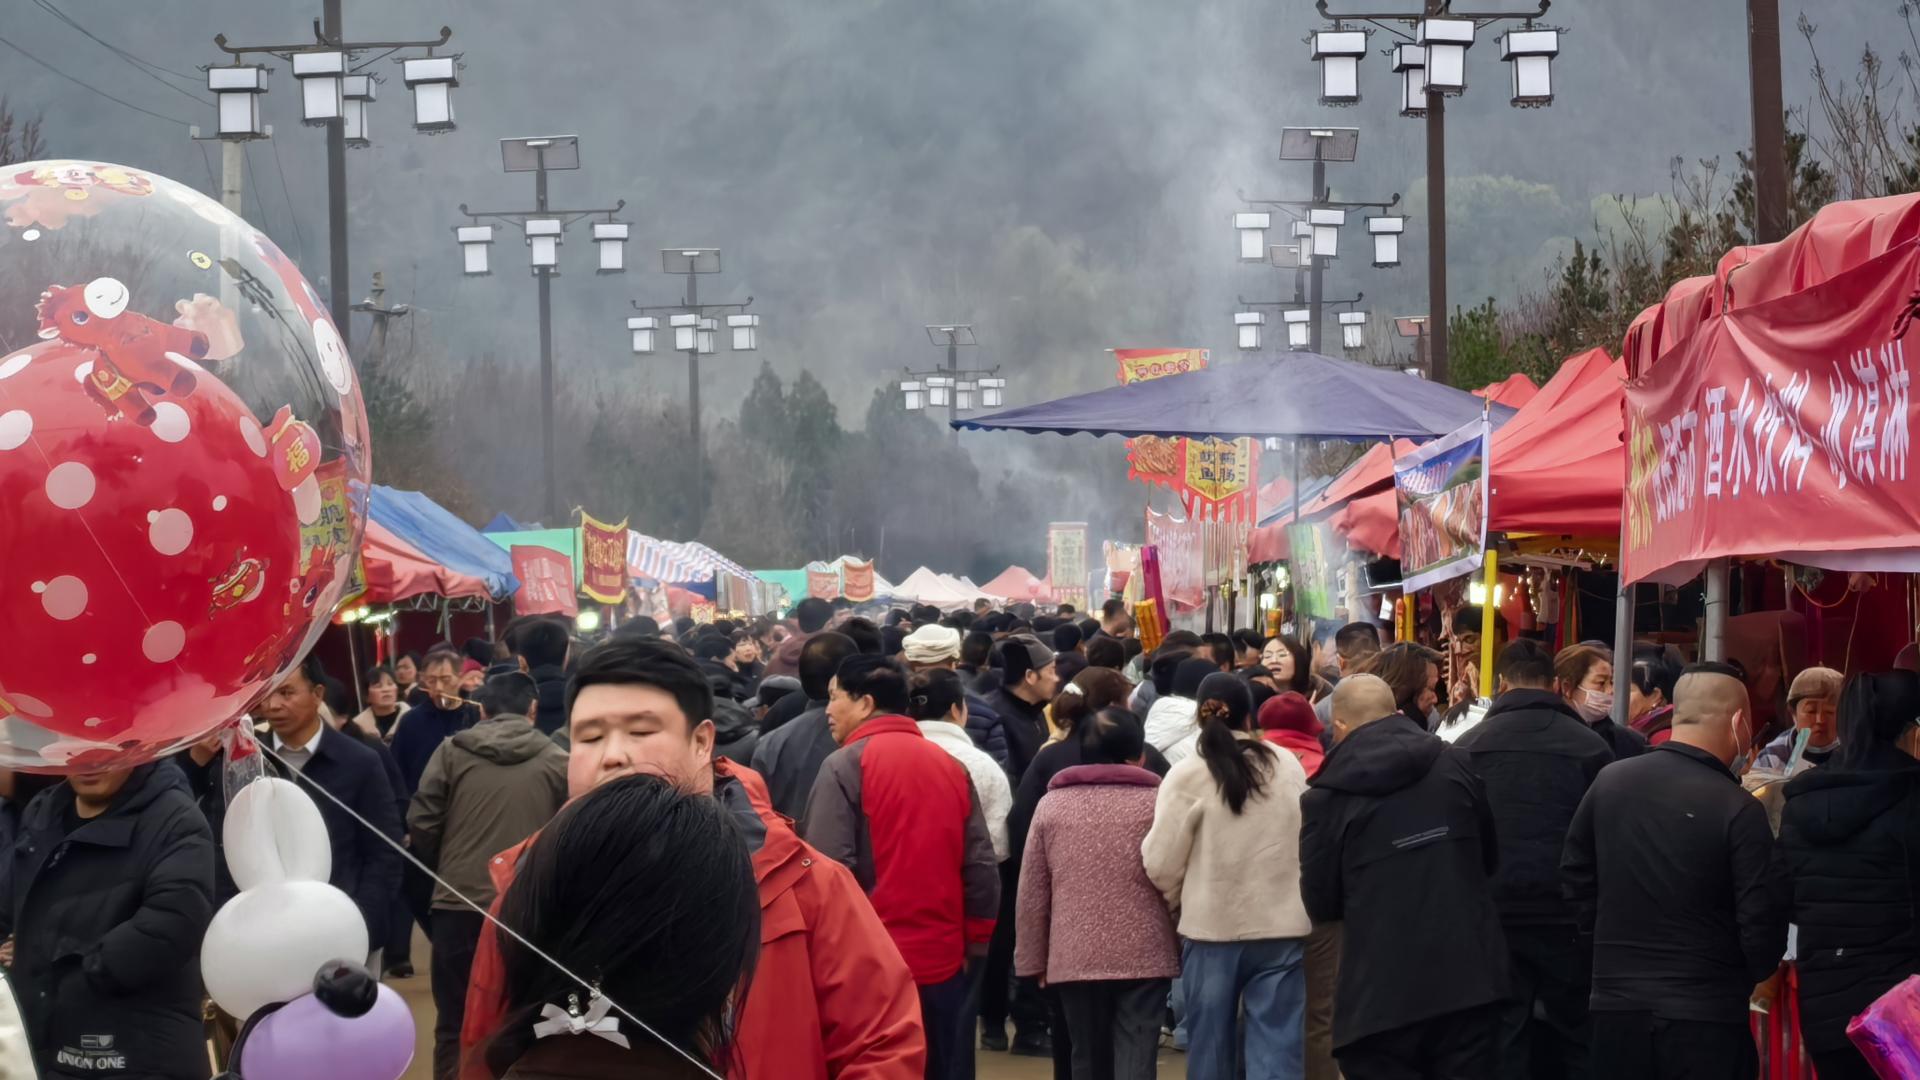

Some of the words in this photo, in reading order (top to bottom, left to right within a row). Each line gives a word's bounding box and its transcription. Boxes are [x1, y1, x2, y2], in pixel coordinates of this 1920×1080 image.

[1820, 339, 1910, 489] 冰淇淋
[286, 438, 309, 472] 福
[97, 1056, 126, 1069] ONE
